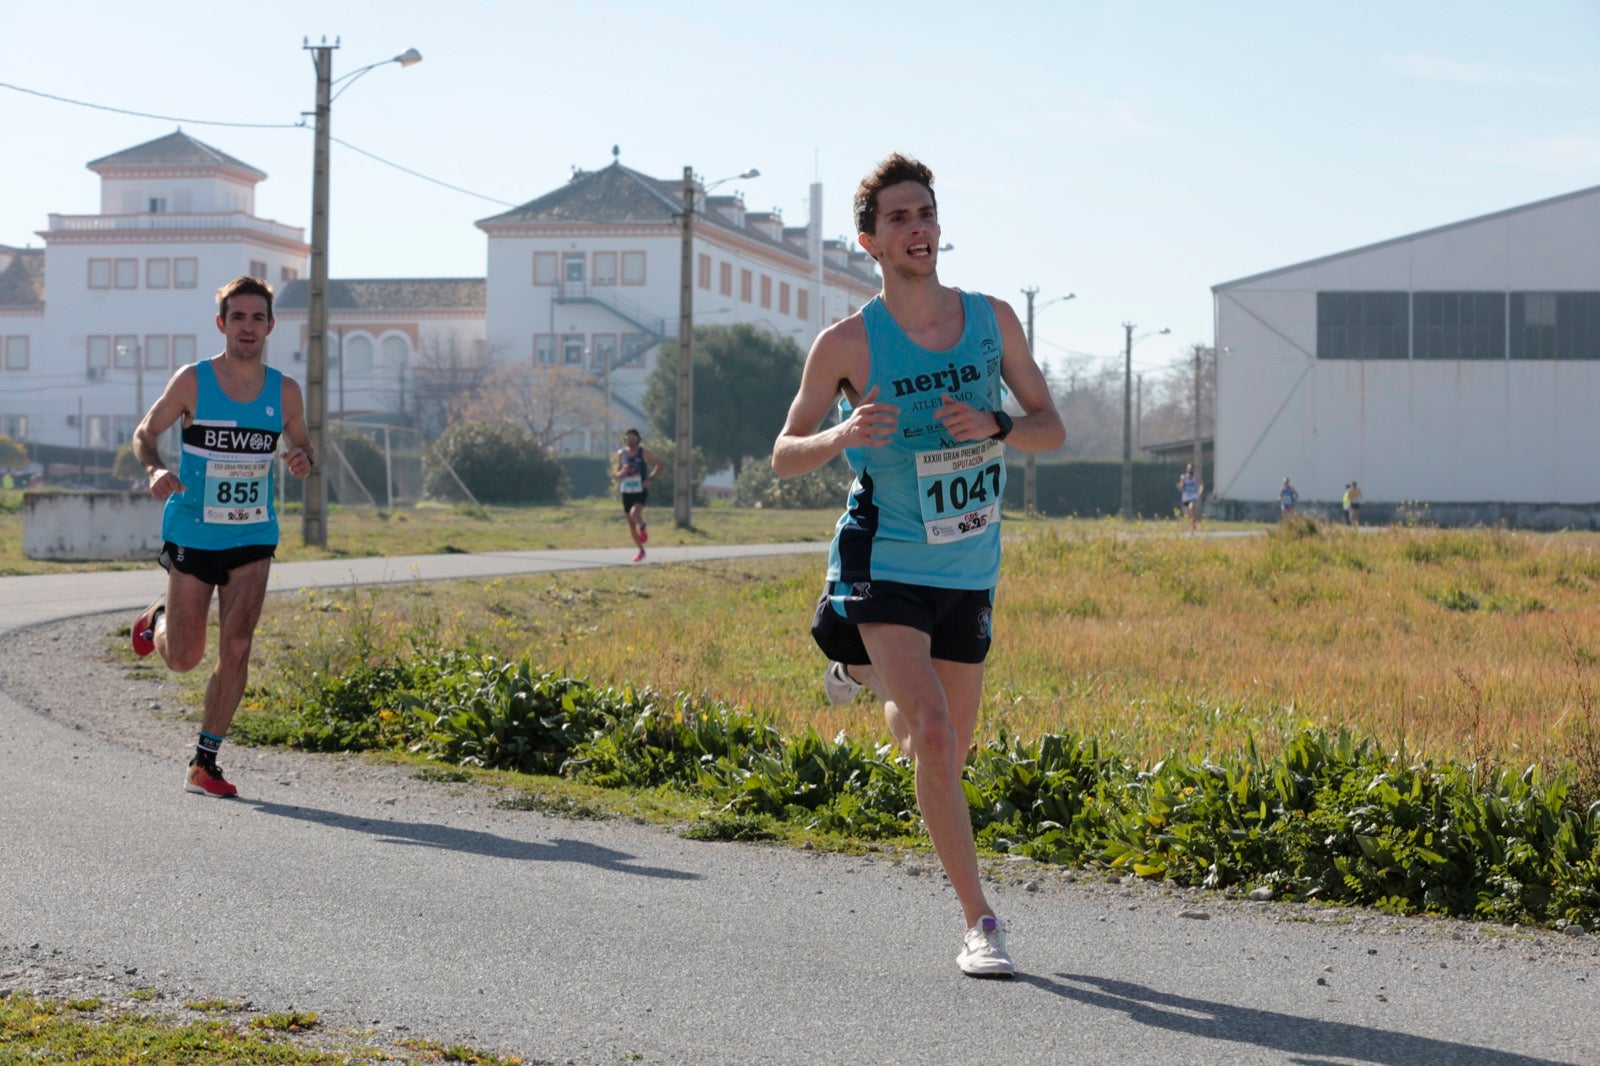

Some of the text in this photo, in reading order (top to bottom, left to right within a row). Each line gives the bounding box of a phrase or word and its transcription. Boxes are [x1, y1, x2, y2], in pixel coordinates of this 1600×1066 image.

[892, 363, 980, 397] nerja
[911, 391, 973, 412] ATLETMO
[204, 430, 273, 450] BEWOR
[943, 451, 960, 462] GRAN
[960, 446, 981, 458] PREMIO
[216, 481, 259, 504] 855
[926, 463, 1001, 513] 1047
